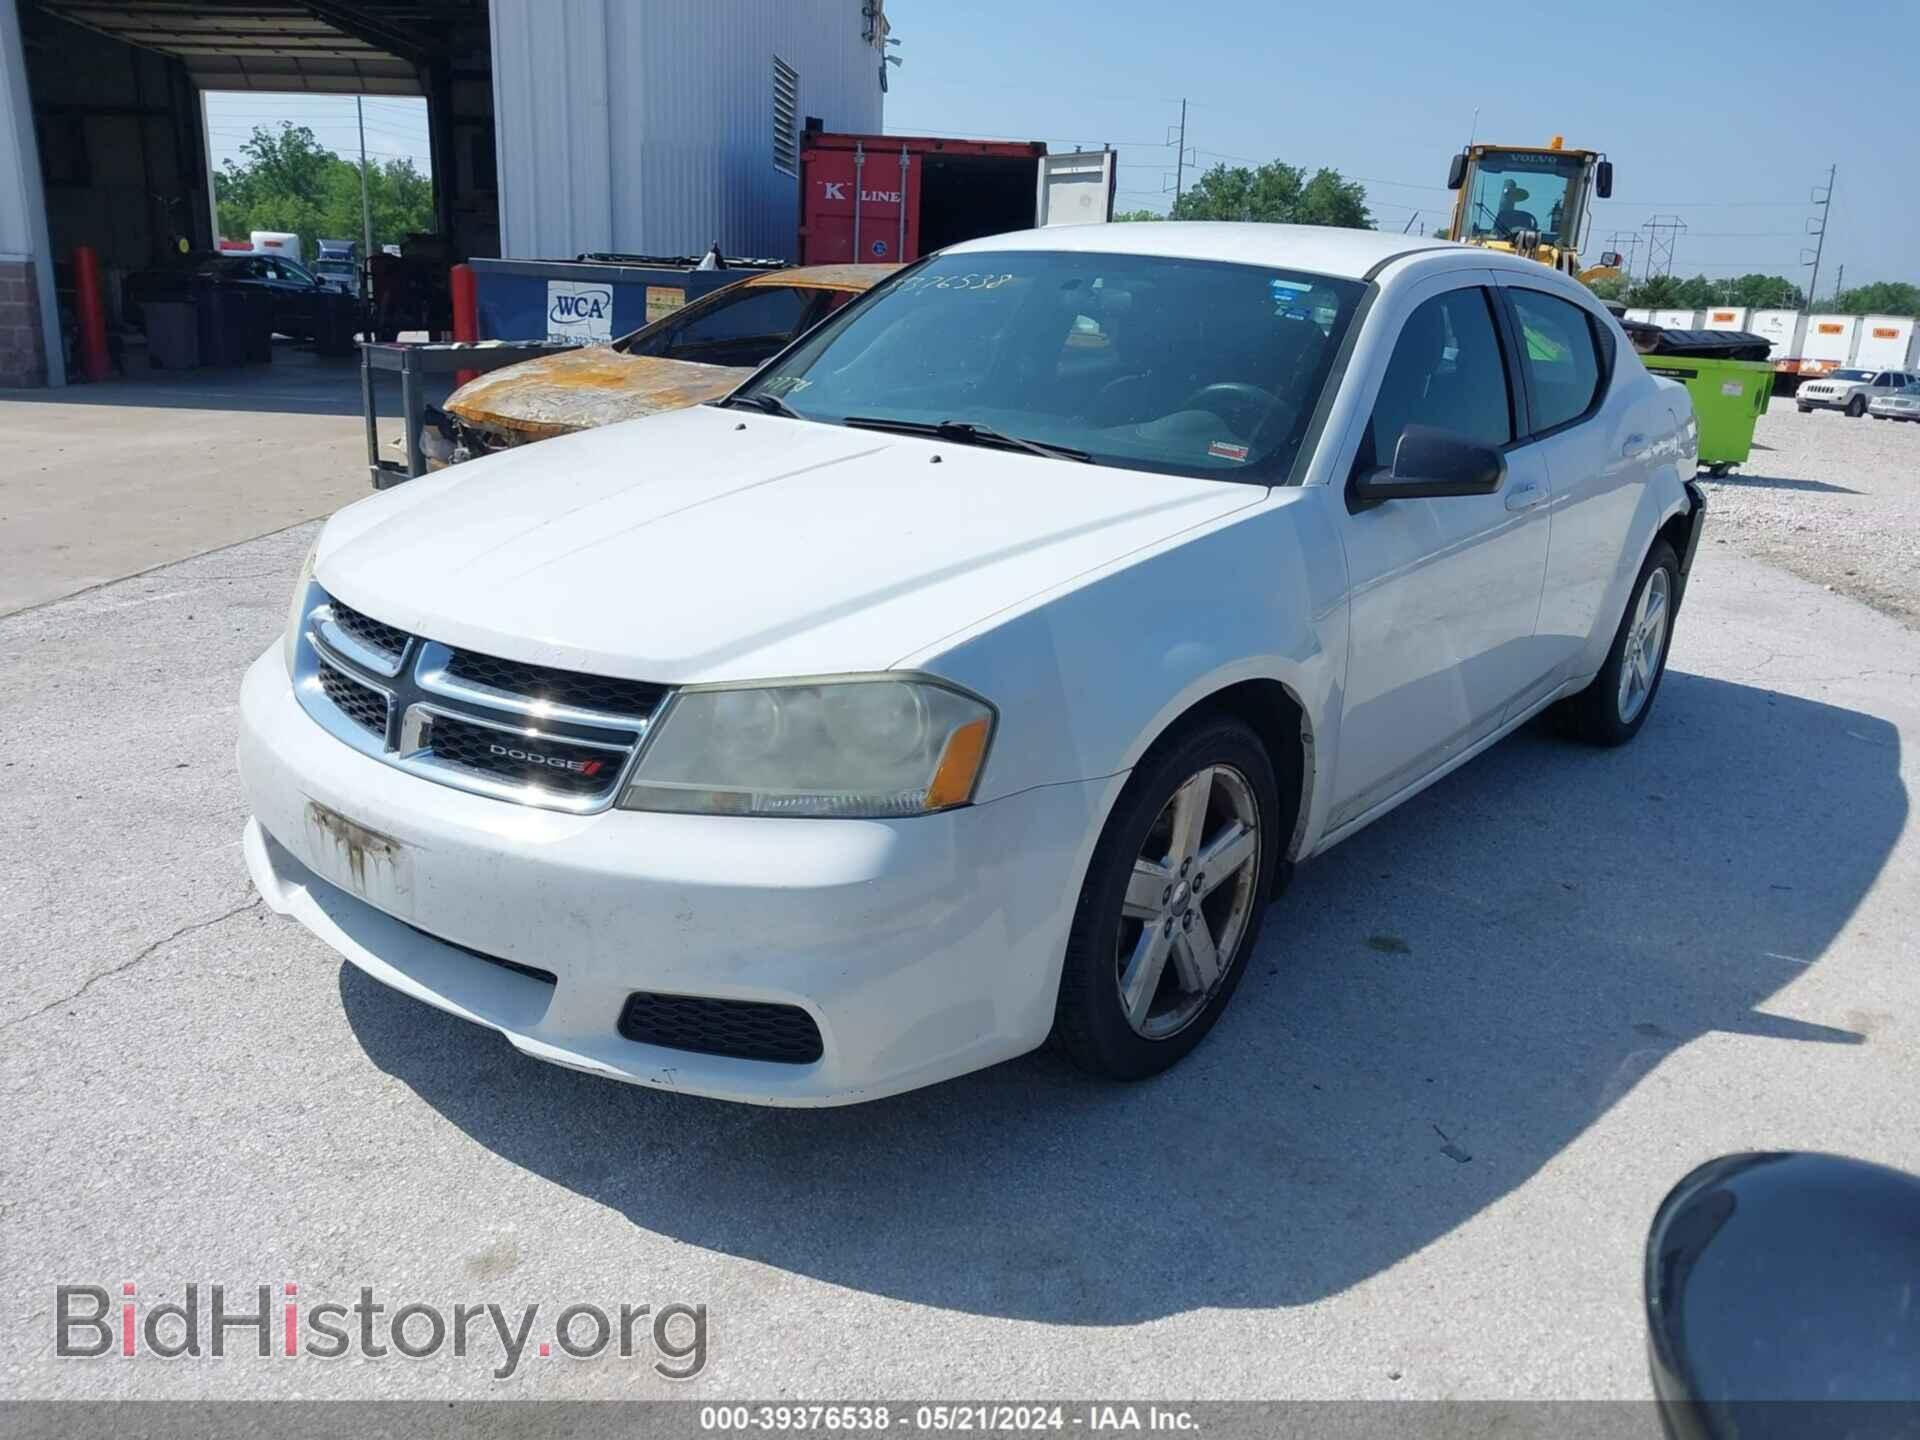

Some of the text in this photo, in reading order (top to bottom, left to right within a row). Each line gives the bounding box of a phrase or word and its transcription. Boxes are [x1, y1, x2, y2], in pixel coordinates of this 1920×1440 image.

[1511, 152, 1557, 164] VOLVO
[861, 190, 901, 203] LINE
[556, 295, 604, 319] WCA
[490, 744, 585, 772] DODGE
